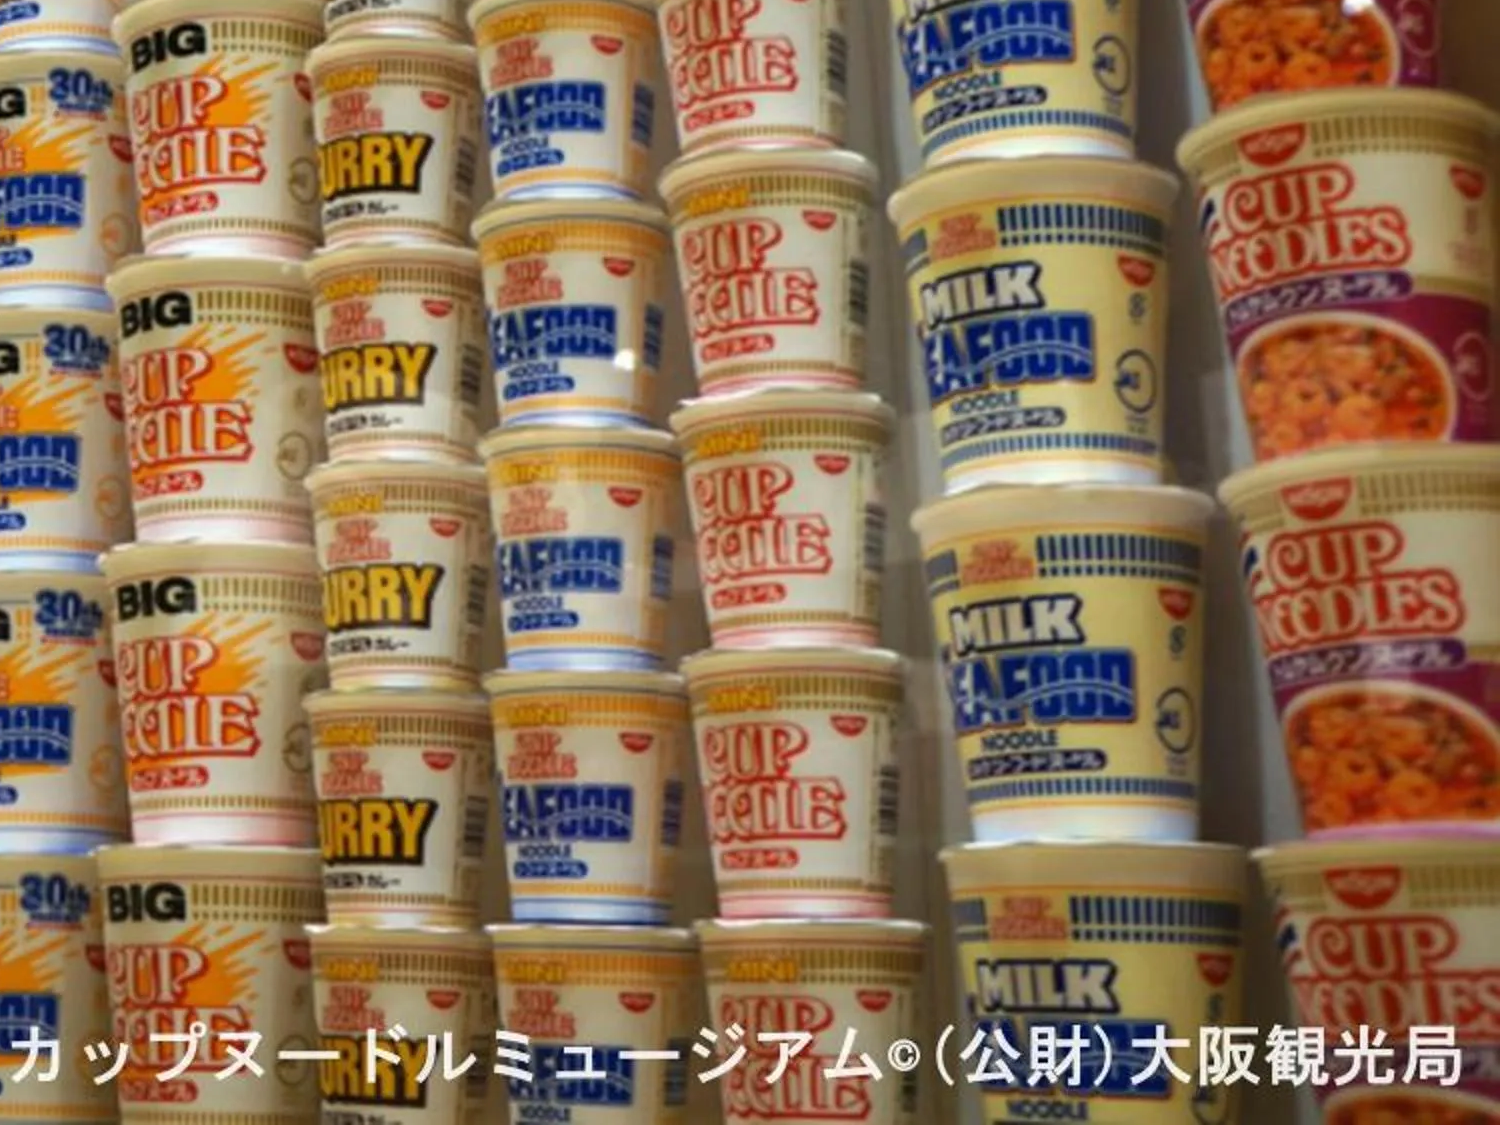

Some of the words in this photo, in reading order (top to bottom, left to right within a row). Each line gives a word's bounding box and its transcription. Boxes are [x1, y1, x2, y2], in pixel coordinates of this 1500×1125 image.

[130, 21, 208, 73] BIG
[317, 132, 433, 196] URRY
[1223, 161, 1354, 239] CUP
[119, 291, 194, 338] BIG
[920, 259, 1042, 329] MILK
[323, 343, 437, 410] URRY
[1266, 520, 1404, 593] CUP
[117, 577, 197, 621] BIG
[322, 562, 445, 633] URRY
[949, 593, 1085, 657] MILK
[318, 798, 440, 865] URRY
[107, 882, 188, 923] BIG
[1307, 915, 1459, 976] CUP
[976, 959, 1120, 1014] MILK
